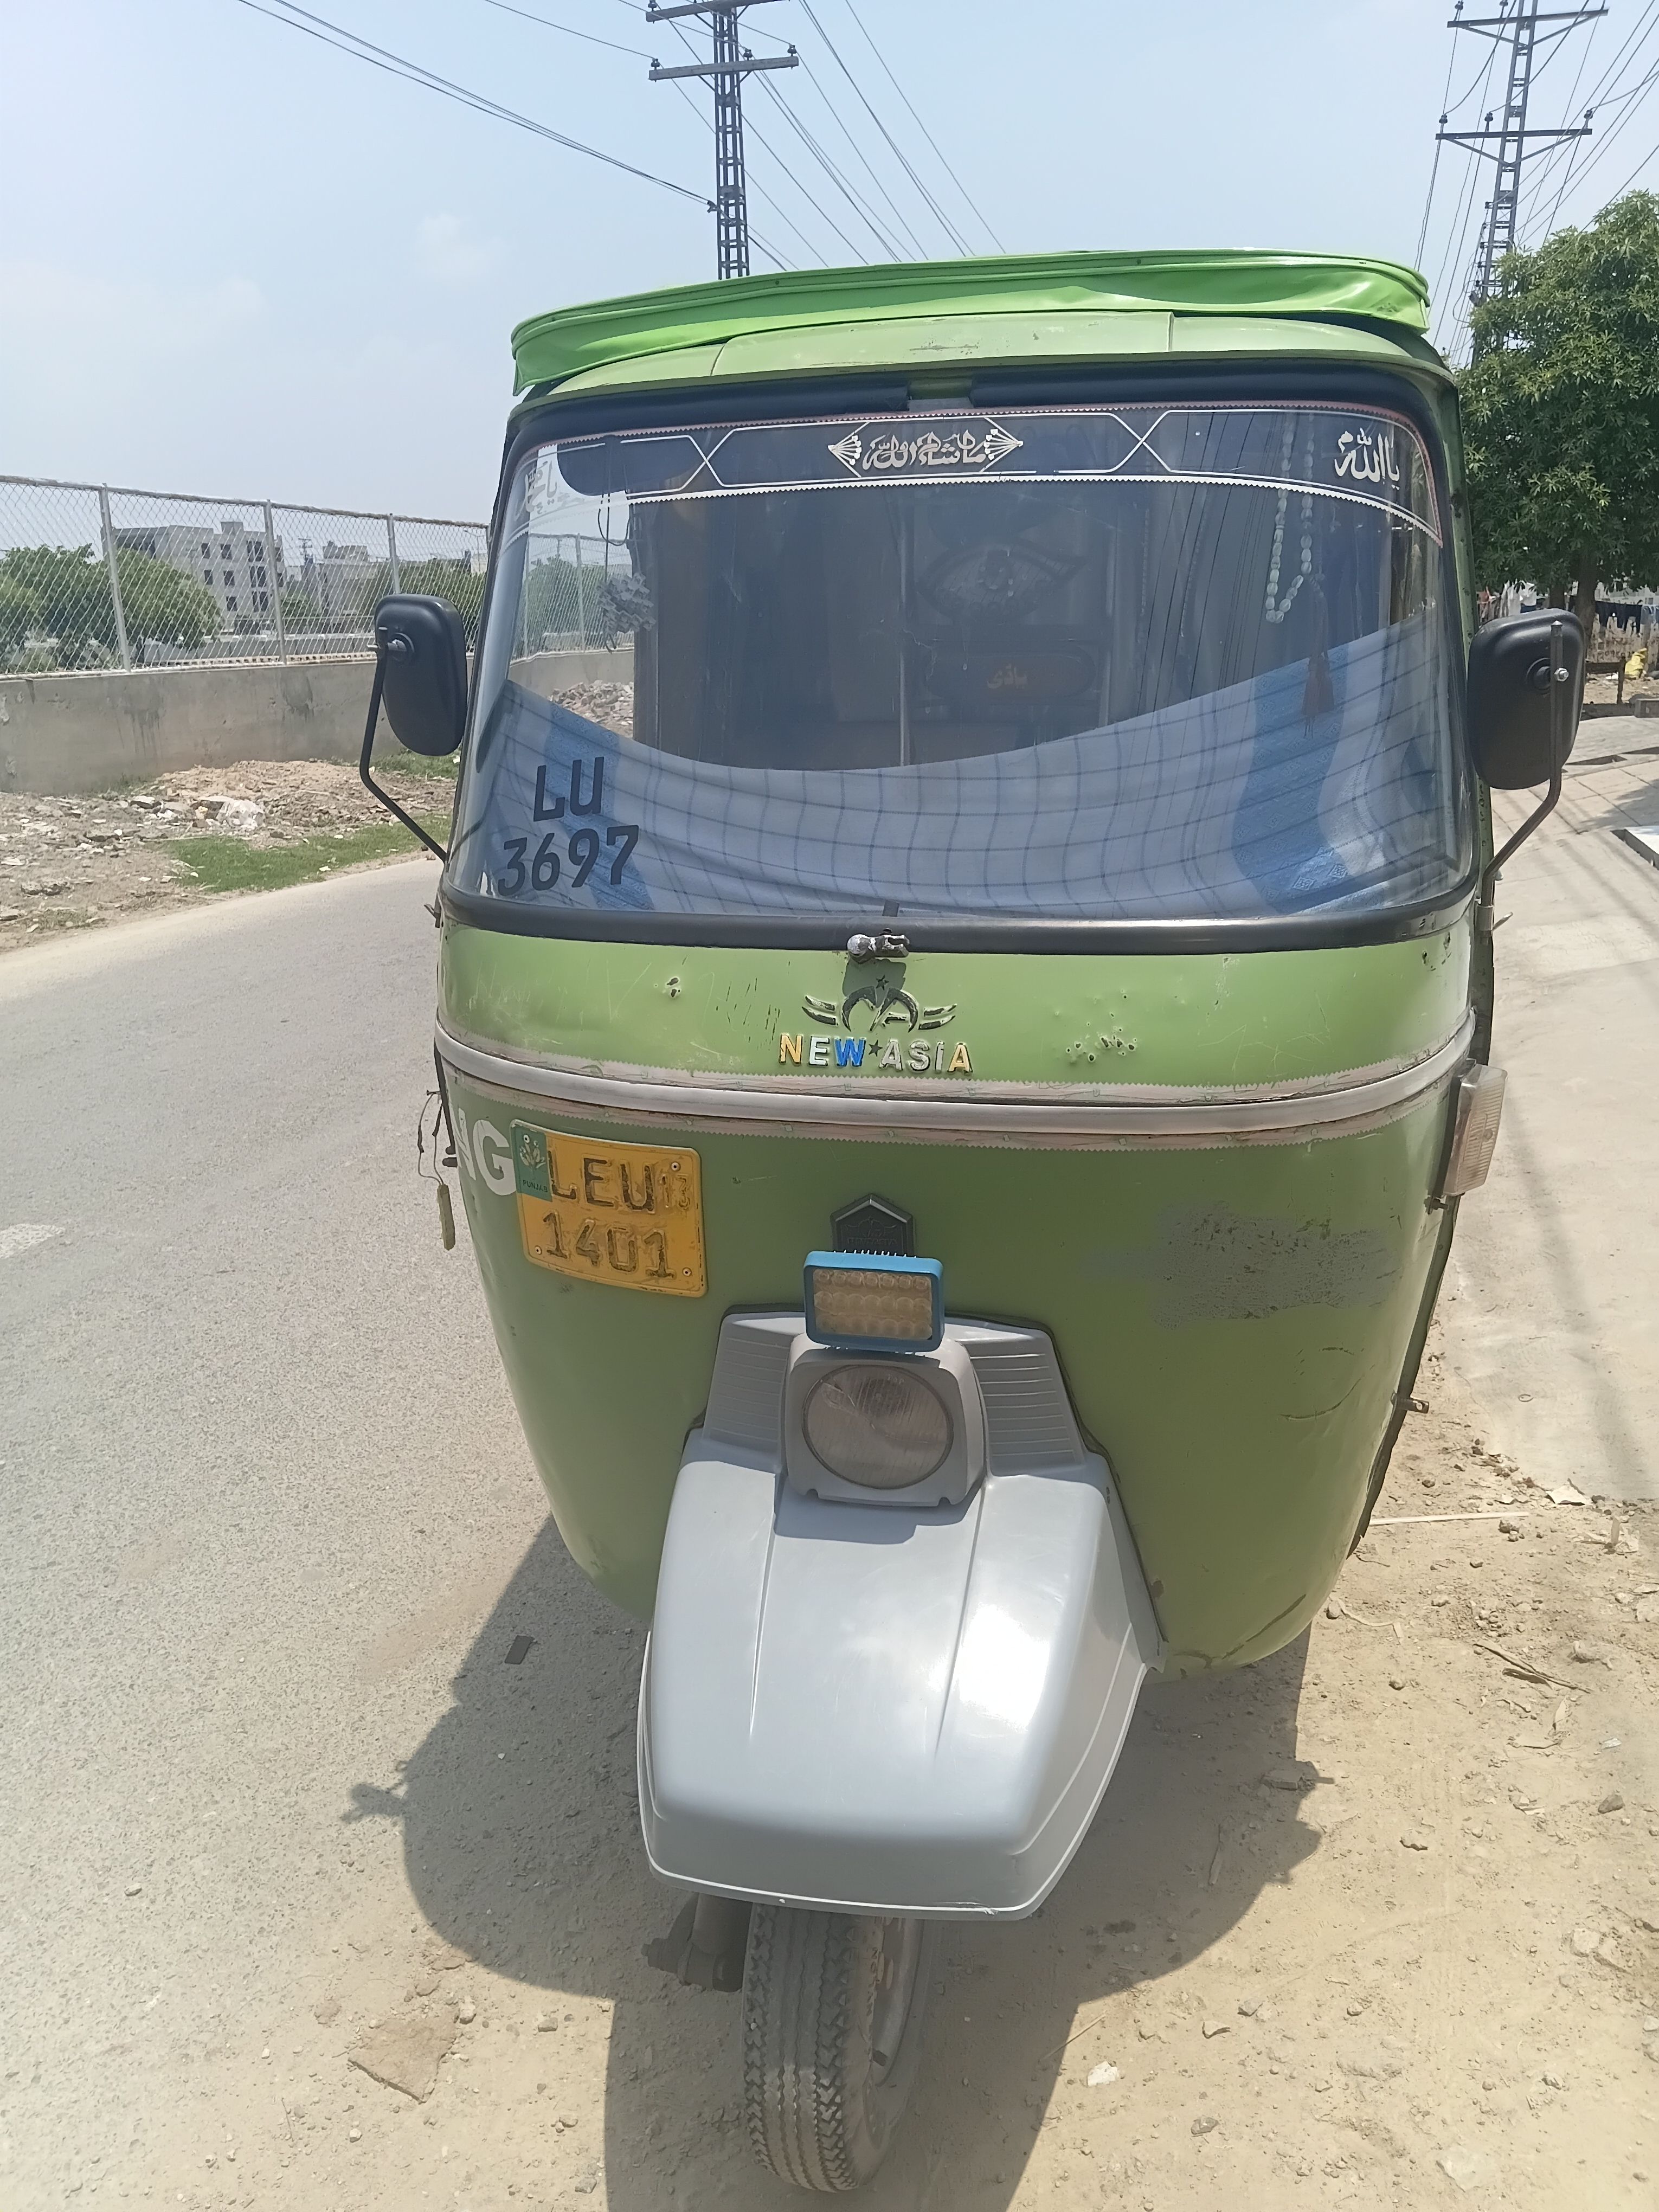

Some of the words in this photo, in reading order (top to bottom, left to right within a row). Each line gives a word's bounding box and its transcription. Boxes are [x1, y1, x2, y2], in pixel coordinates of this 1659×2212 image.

[533, 756, 605, 822] LU
[498, 825, 639, 896] 3697
[779, 1034, 867, 1068] NEW
[879, 1040, 974, 1073] ASIA
[523, 1179, 548, 1193] PUNJAB
[548, 1150, 656, 1214] LEU
[543, 1210, 676, 1279] 1401
